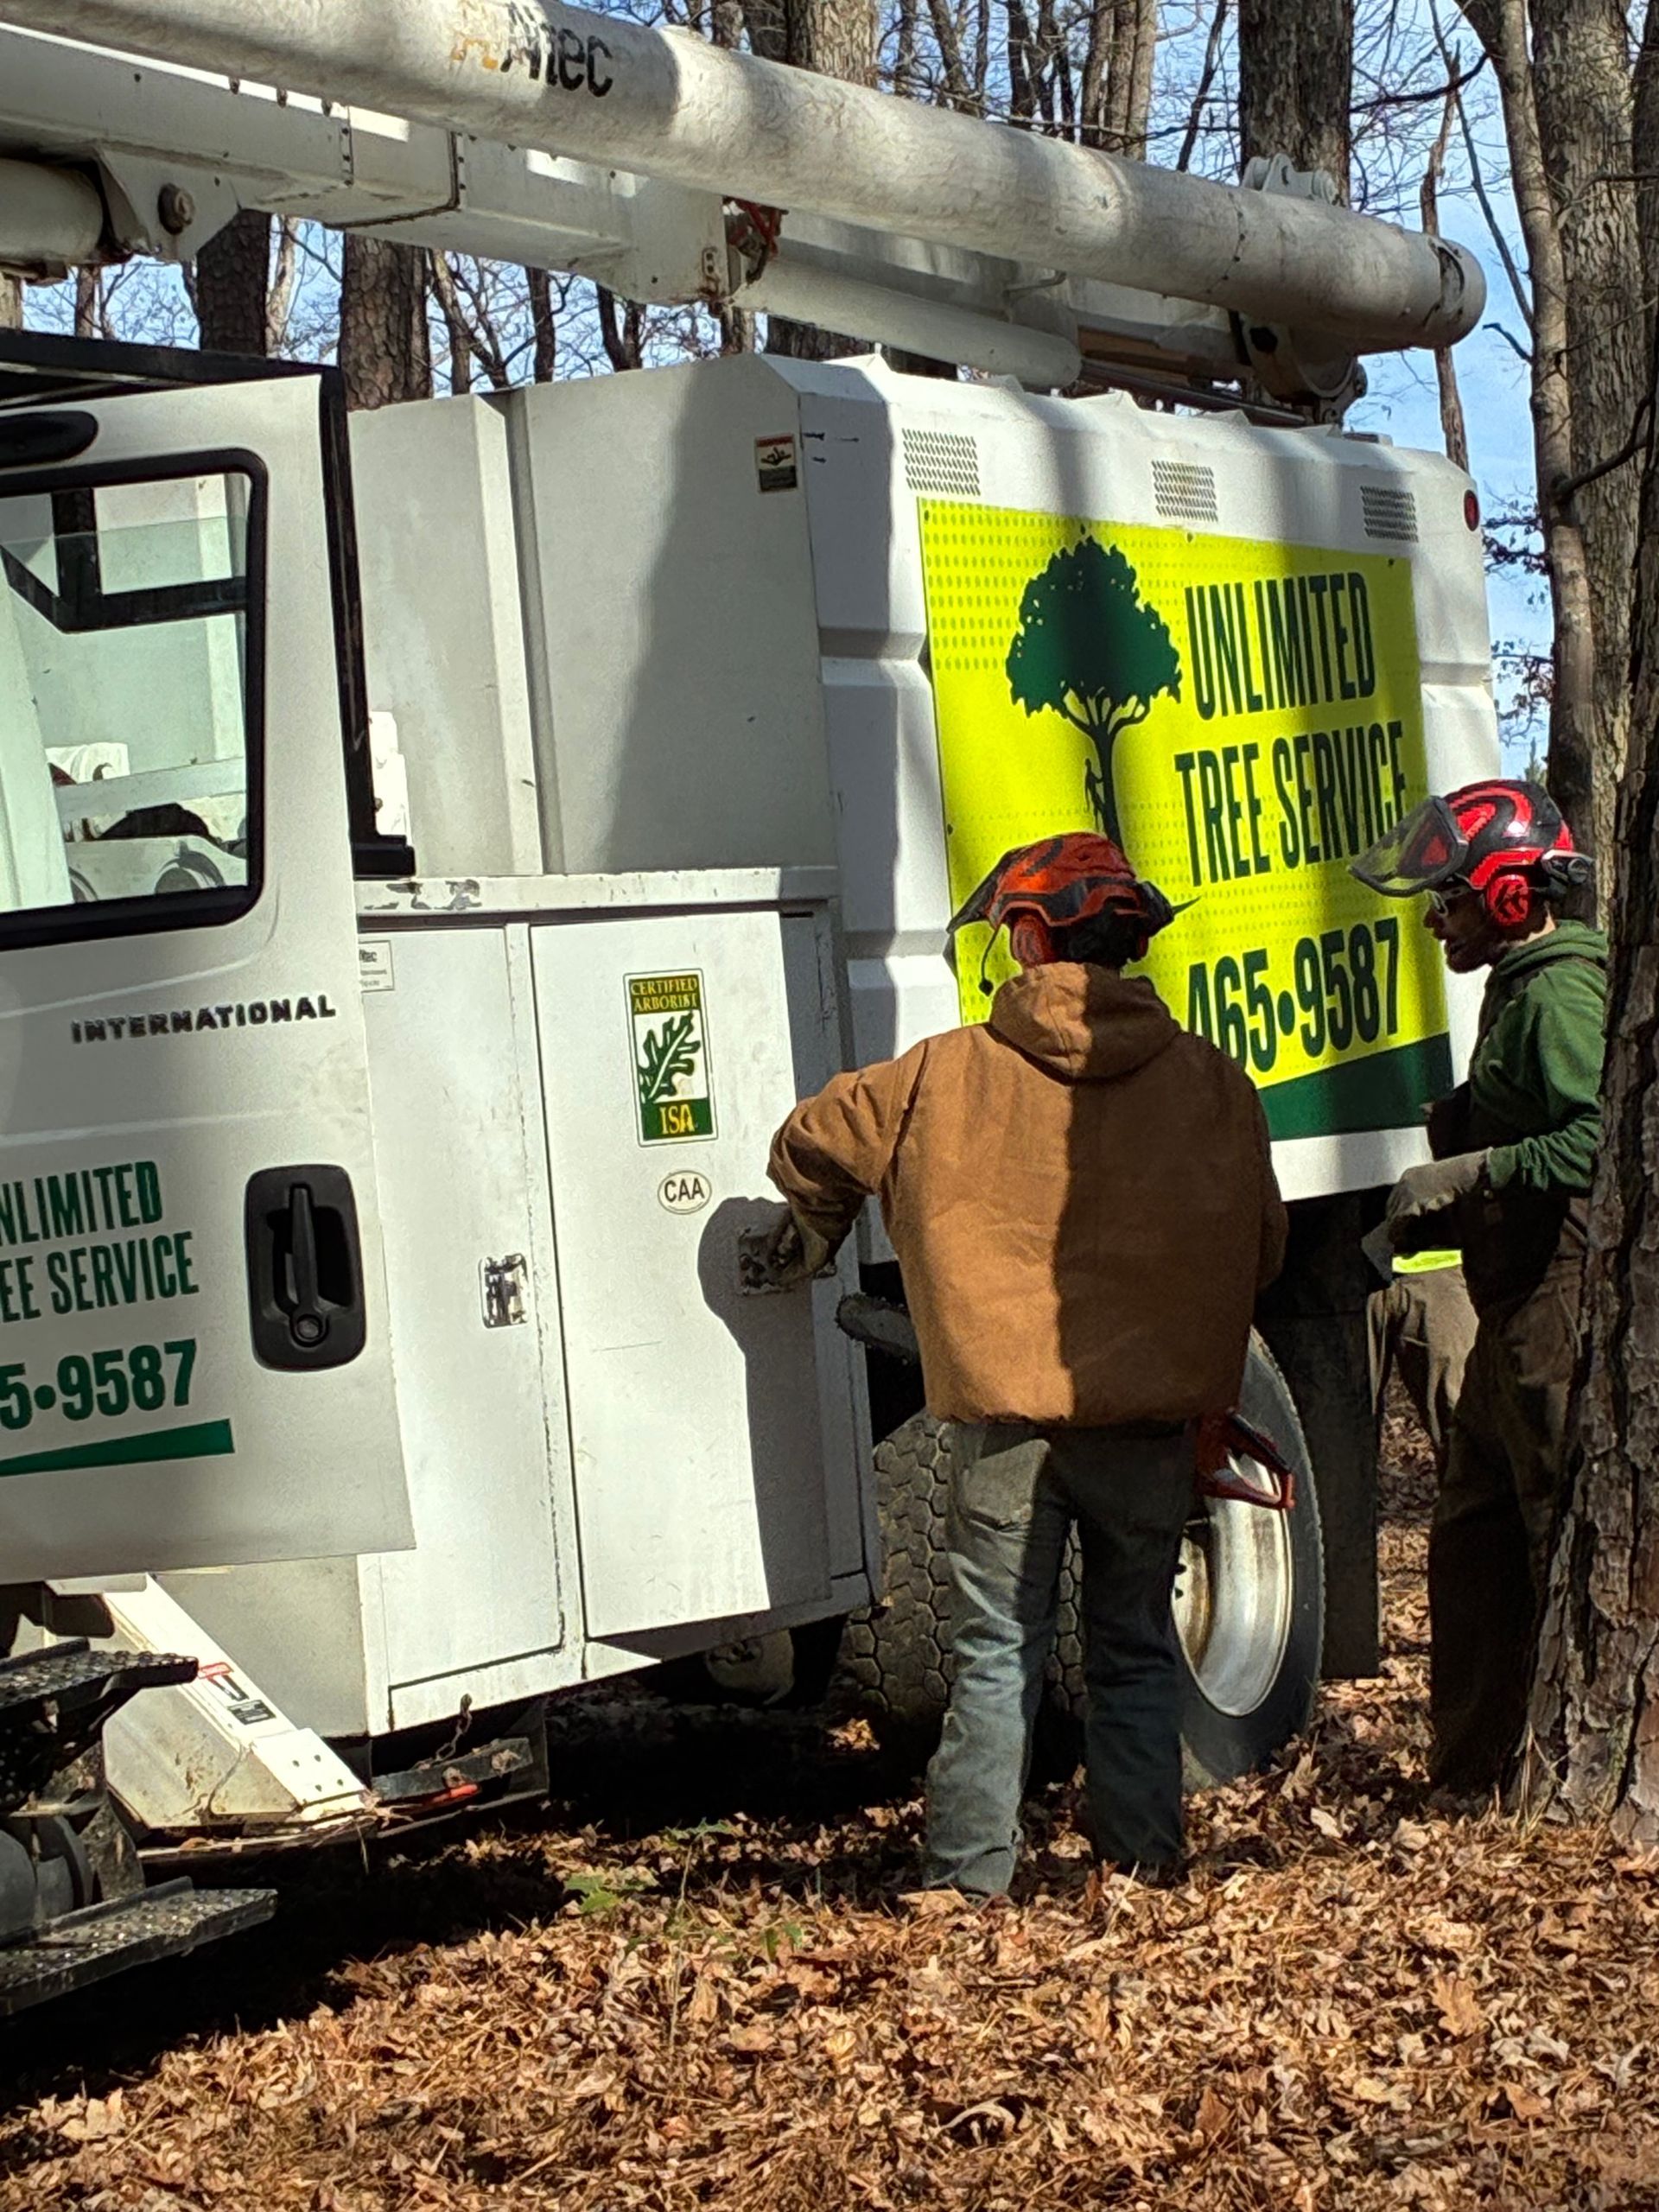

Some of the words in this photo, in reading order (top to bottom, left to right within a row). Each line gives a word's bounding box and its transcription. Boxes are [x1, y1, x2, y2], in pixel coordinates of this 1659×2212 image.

[1185, 572, 1376, 721] UNLIMITED
[1174, 742, 1271, 887] TREE
[1272, 721, 1406, 869] SERVICE
[630, 977, 698, 996] CERTIFIED
[633, 993, 698, 1013] ARBORIST
[71, 995, 336, 1044] INTERNATIONAL
[659, 1104, 696, 1135] ISA
[664, 1177, 706, 1203] CAA
[47, 1230, 200, 1314] SERVICE
